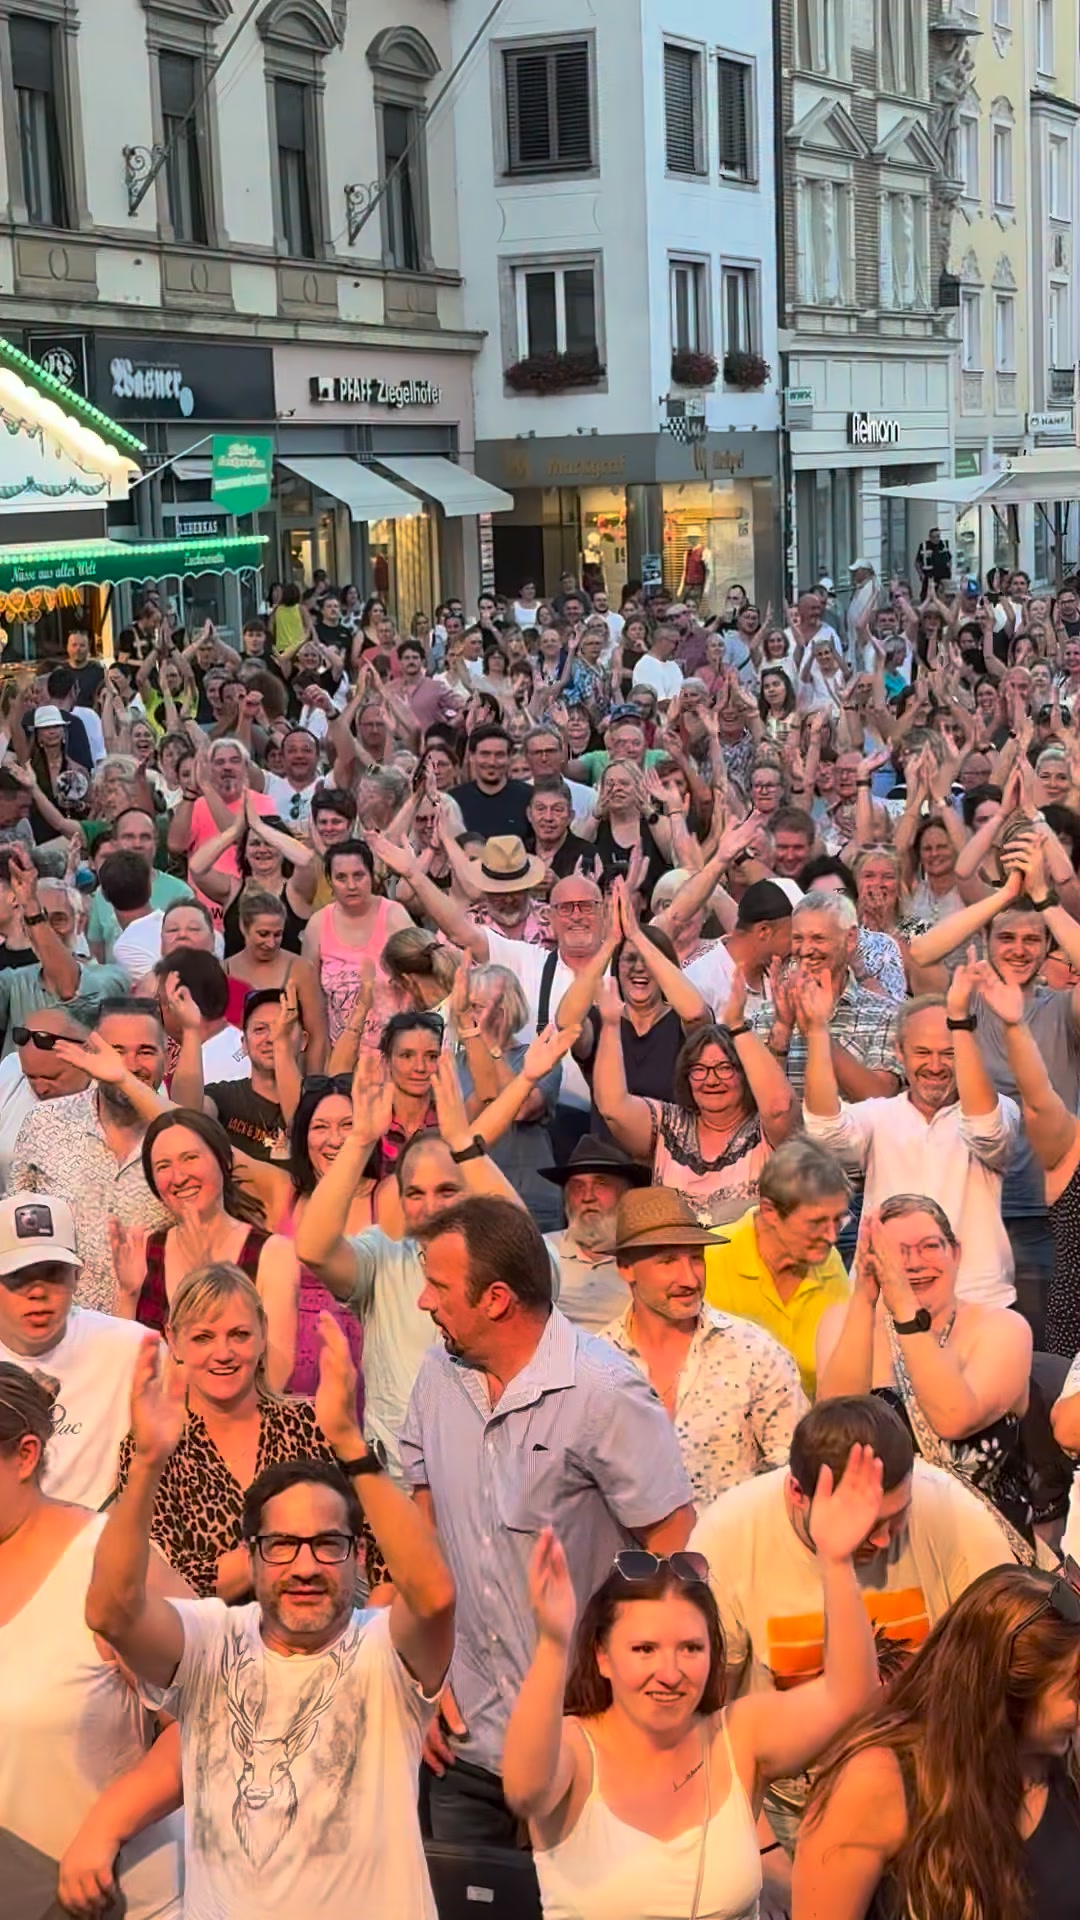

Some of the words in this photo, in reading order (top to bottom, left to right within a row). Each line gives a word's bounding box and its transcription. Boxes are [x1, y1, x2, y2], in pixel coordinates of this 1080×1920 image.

[110, 357, 182, 399] Wasner
[341, 378, 371, 402] PFAFF
[376, 379, 442, 408] Ziegelhöfer
[11, 565, 36, 582] Nüsse
[55, 561, 75, 579] aller
